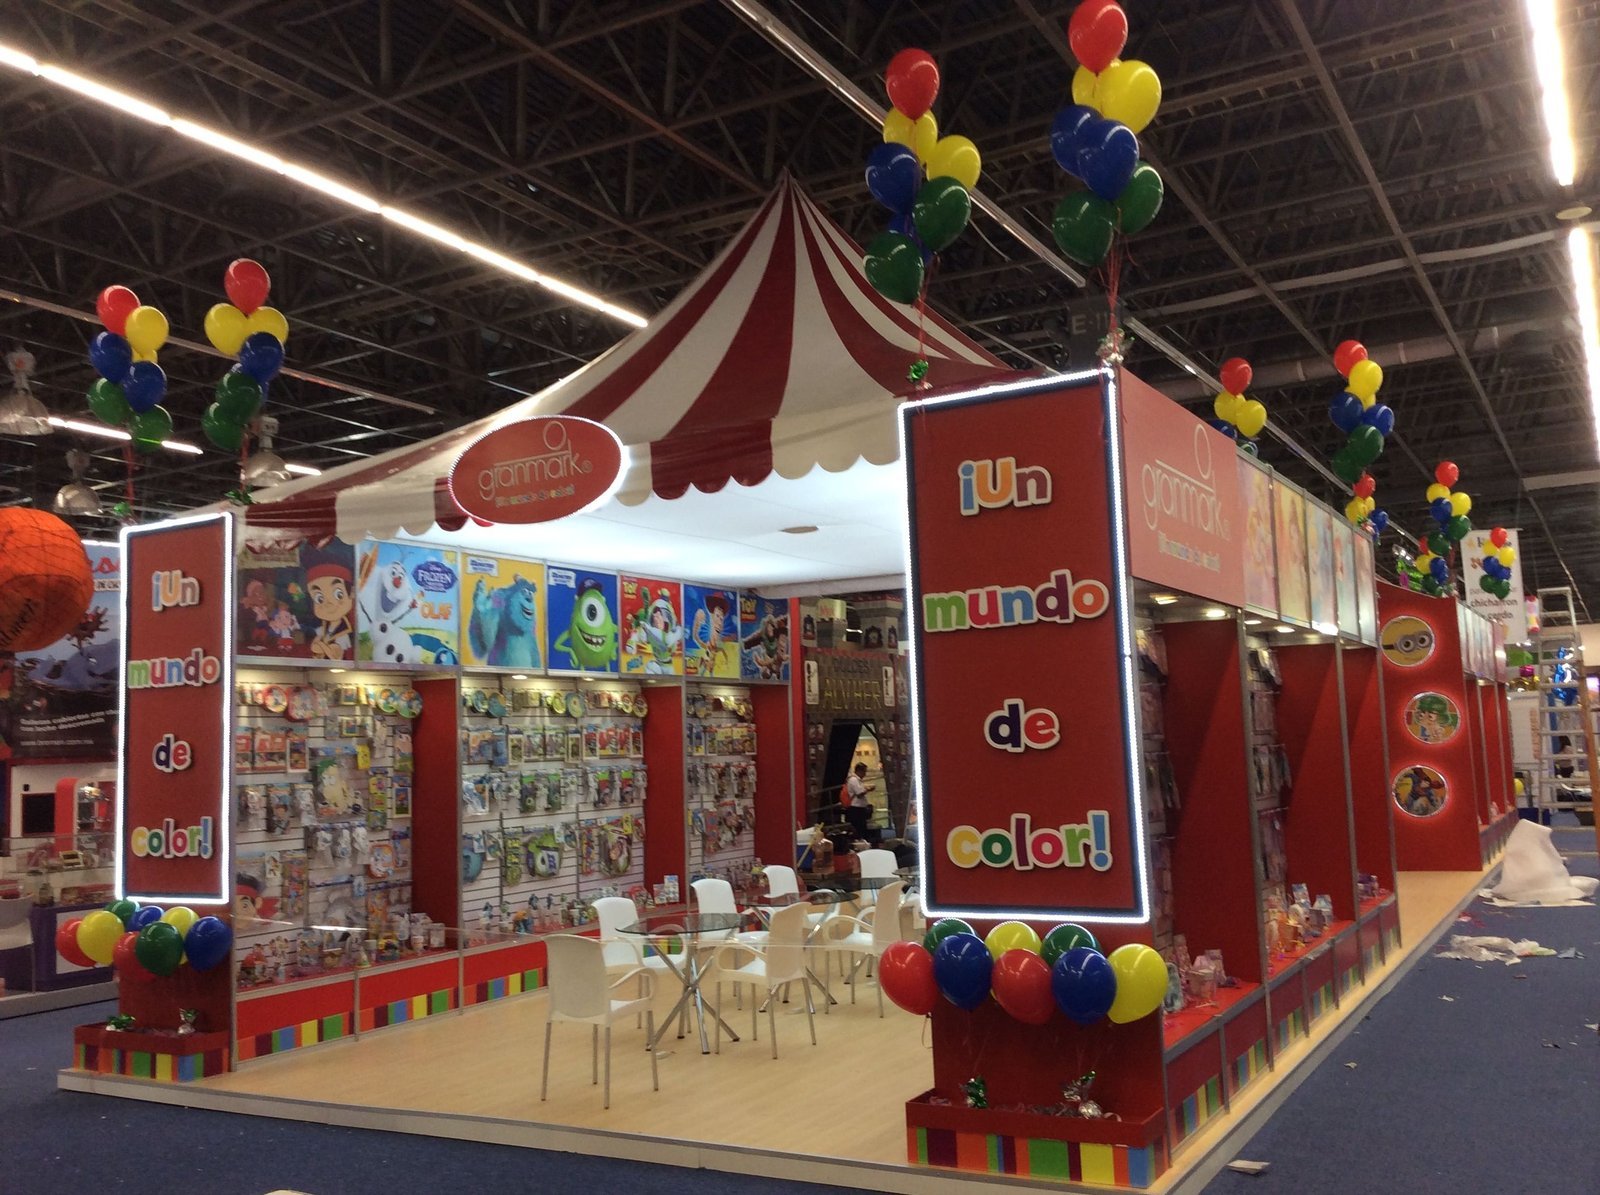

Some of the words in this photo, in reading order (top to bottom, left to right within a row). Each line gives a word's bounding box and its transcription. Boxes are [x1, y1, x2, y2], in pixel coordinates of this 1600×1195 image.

[478, 439, 583, 501] granmark
[1142, 463, 1227, 538] granmark
[417, 570, 452, 584] FROZEN
[923, 569, 1109, 632] mundo
[418, 602, 452, 620] OLAF
[127, 648, 220, 689] mundo
[984, 698, 1060, 752] de
[152, 733, 192, 773] de
[131, 816, 213, 859] color!
[947, 810, 1112, 871] color!
